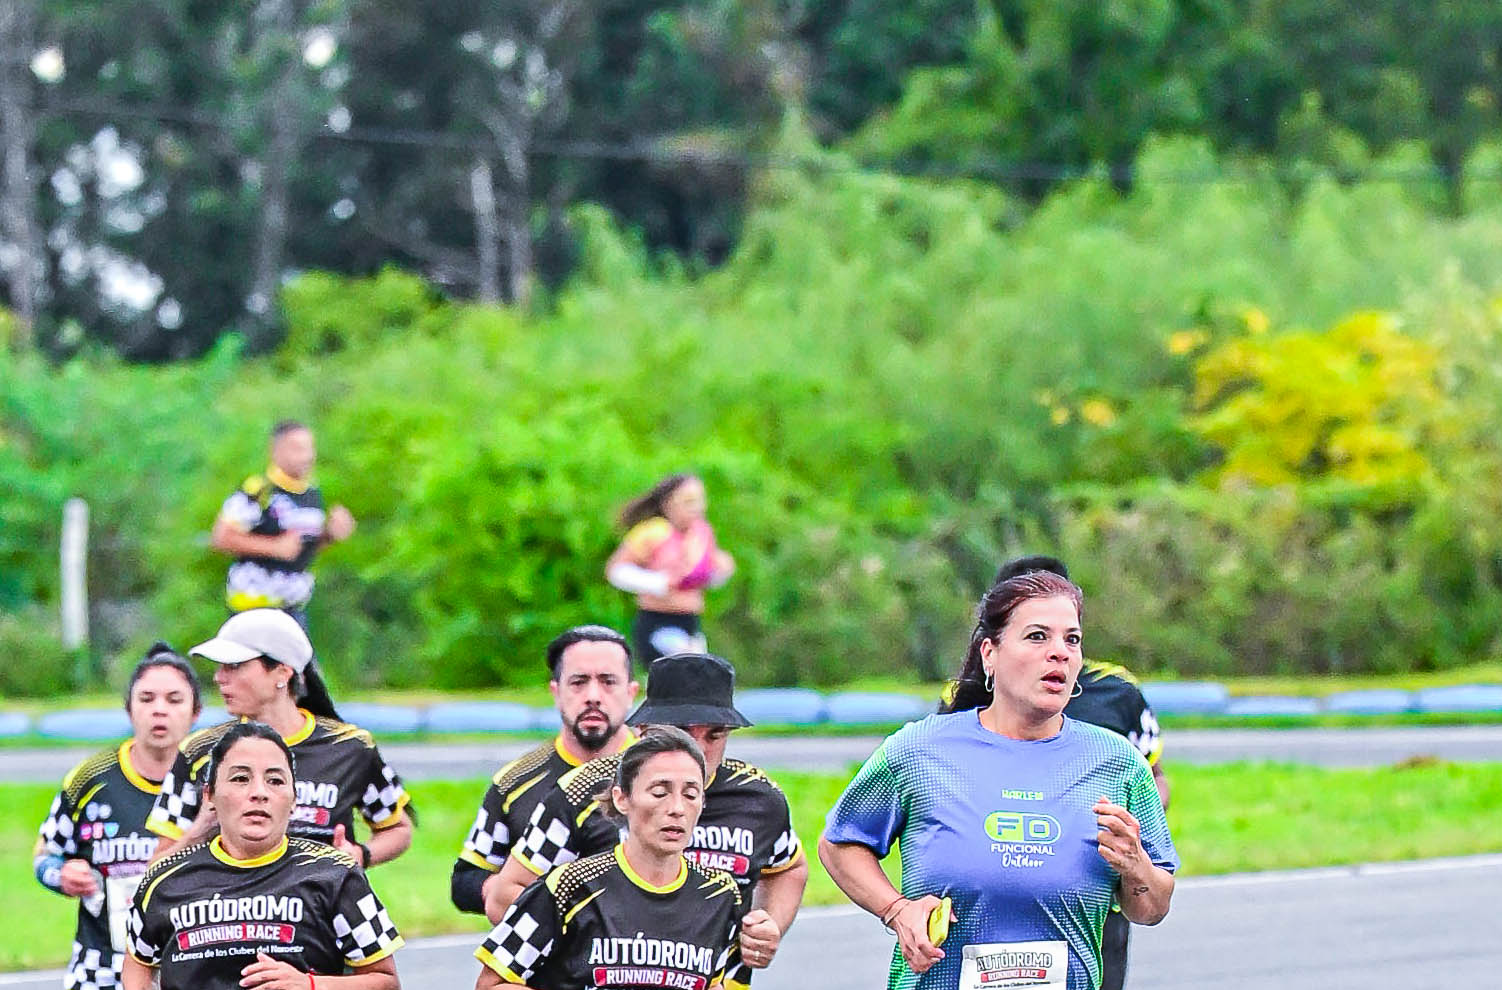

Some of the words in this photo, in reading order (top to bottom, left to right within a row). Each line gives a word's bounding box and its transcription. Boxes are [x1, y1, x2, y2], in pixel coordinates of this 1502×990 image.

[991, 843, 1055, 856] FUNCIONAL
[1002, 852, 1044, 868] Outdoor
[700, 851, 736, 872] RACE
[170, 893, 303, 930] AUTÓDROMO
[188, 925, 243, 946] RUNNING
[246, 925, 280, 940] RACE
[205, 949, 215, 958] de
[216, 949, 228, 957] los
[228, 947, 255, 955] Clubes
[588, 932, 713, 975] AUTÓDROMO
[976, 949, 1052, 972] AUTÓDROMO
[606, 969, 663, 985] RUNNING
[665, 972, 698, 990] RACE
